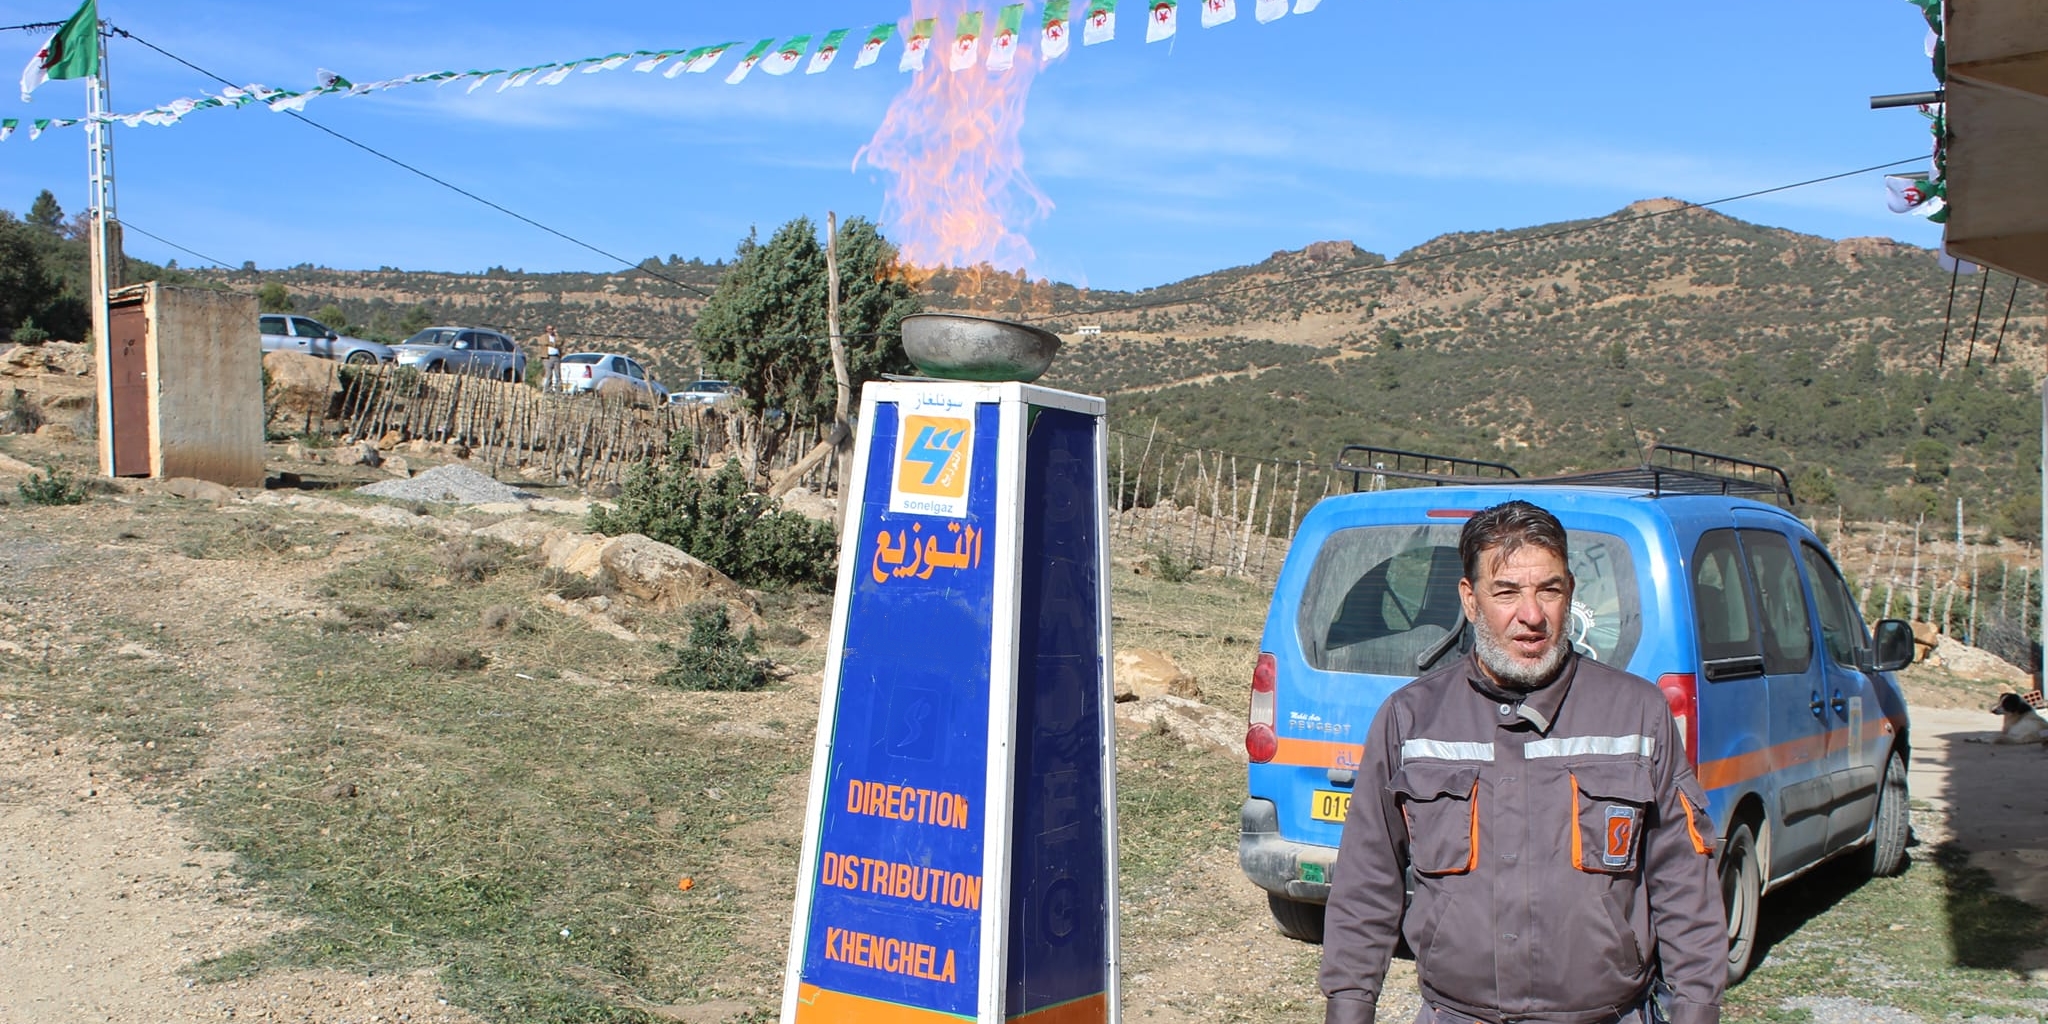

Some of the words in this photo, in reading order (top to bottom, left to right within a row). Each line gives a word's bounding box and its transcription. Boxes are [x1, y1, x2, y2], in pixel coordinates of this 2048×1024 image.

[903, 498, 953, 515] sonelgaz
[872, 522, 983, 584] التوزيع
[1289, 719, 1352, 733] PEUGEOT
[846, 779, 968, 829] DIRECTION
[822, 852, 983, 910] DISTRIBUTION
[825, 926, 956, 983] KHENCHELA
